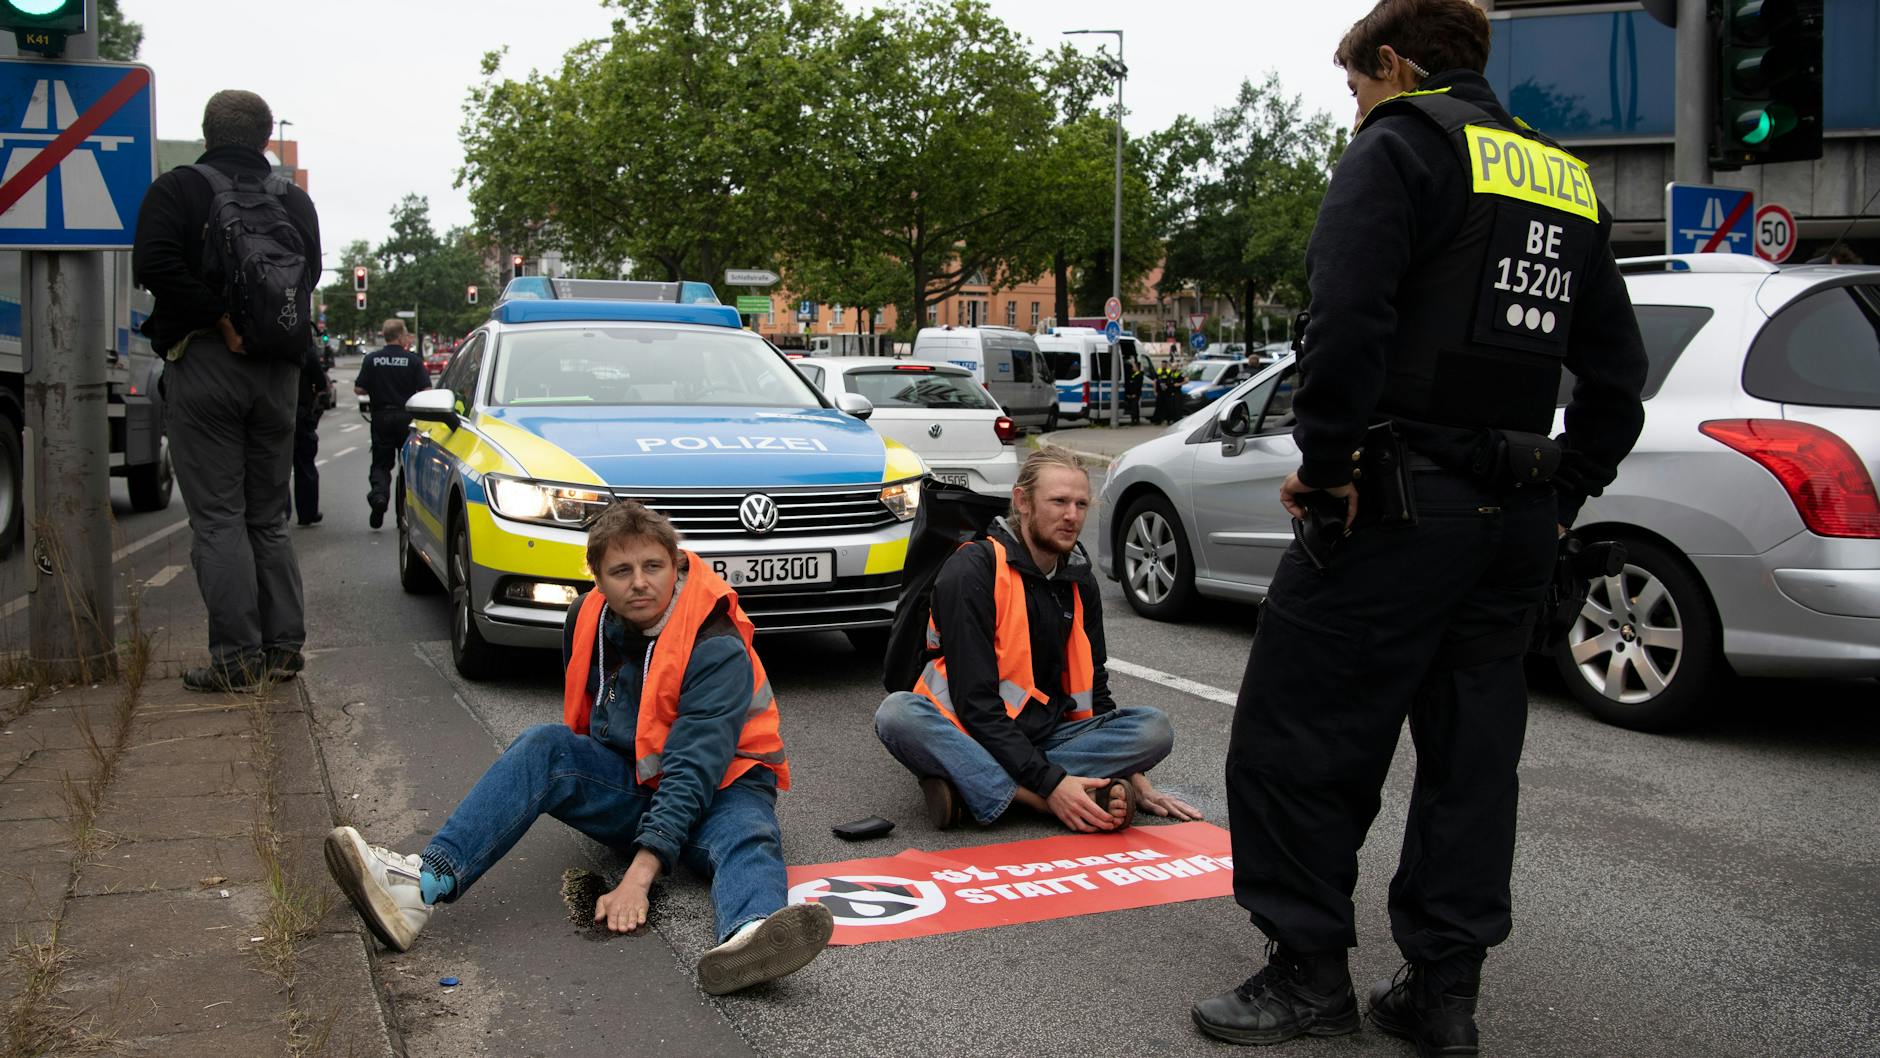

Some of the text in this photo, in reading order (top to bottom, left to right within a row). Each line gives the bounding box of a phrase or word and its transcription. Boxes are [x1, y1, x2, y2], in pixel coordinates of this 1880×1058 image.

[26, 34, 49, 45] K41
[1477, 136, 1594, 210] POLIZEI
[1526, 220, 1563, 259] BE
[1761, 220, 1786, 247] 50
[1494, 257, 1573, 303] 15201
[373, 356, 409, 367] POLIZEI
[636, 436, 828, 452] POLIZEI
[745, 556, 818, 582] 30300
[931, 865, 999, 884] ÖL
[954, 873, 1099, 905] STATT
